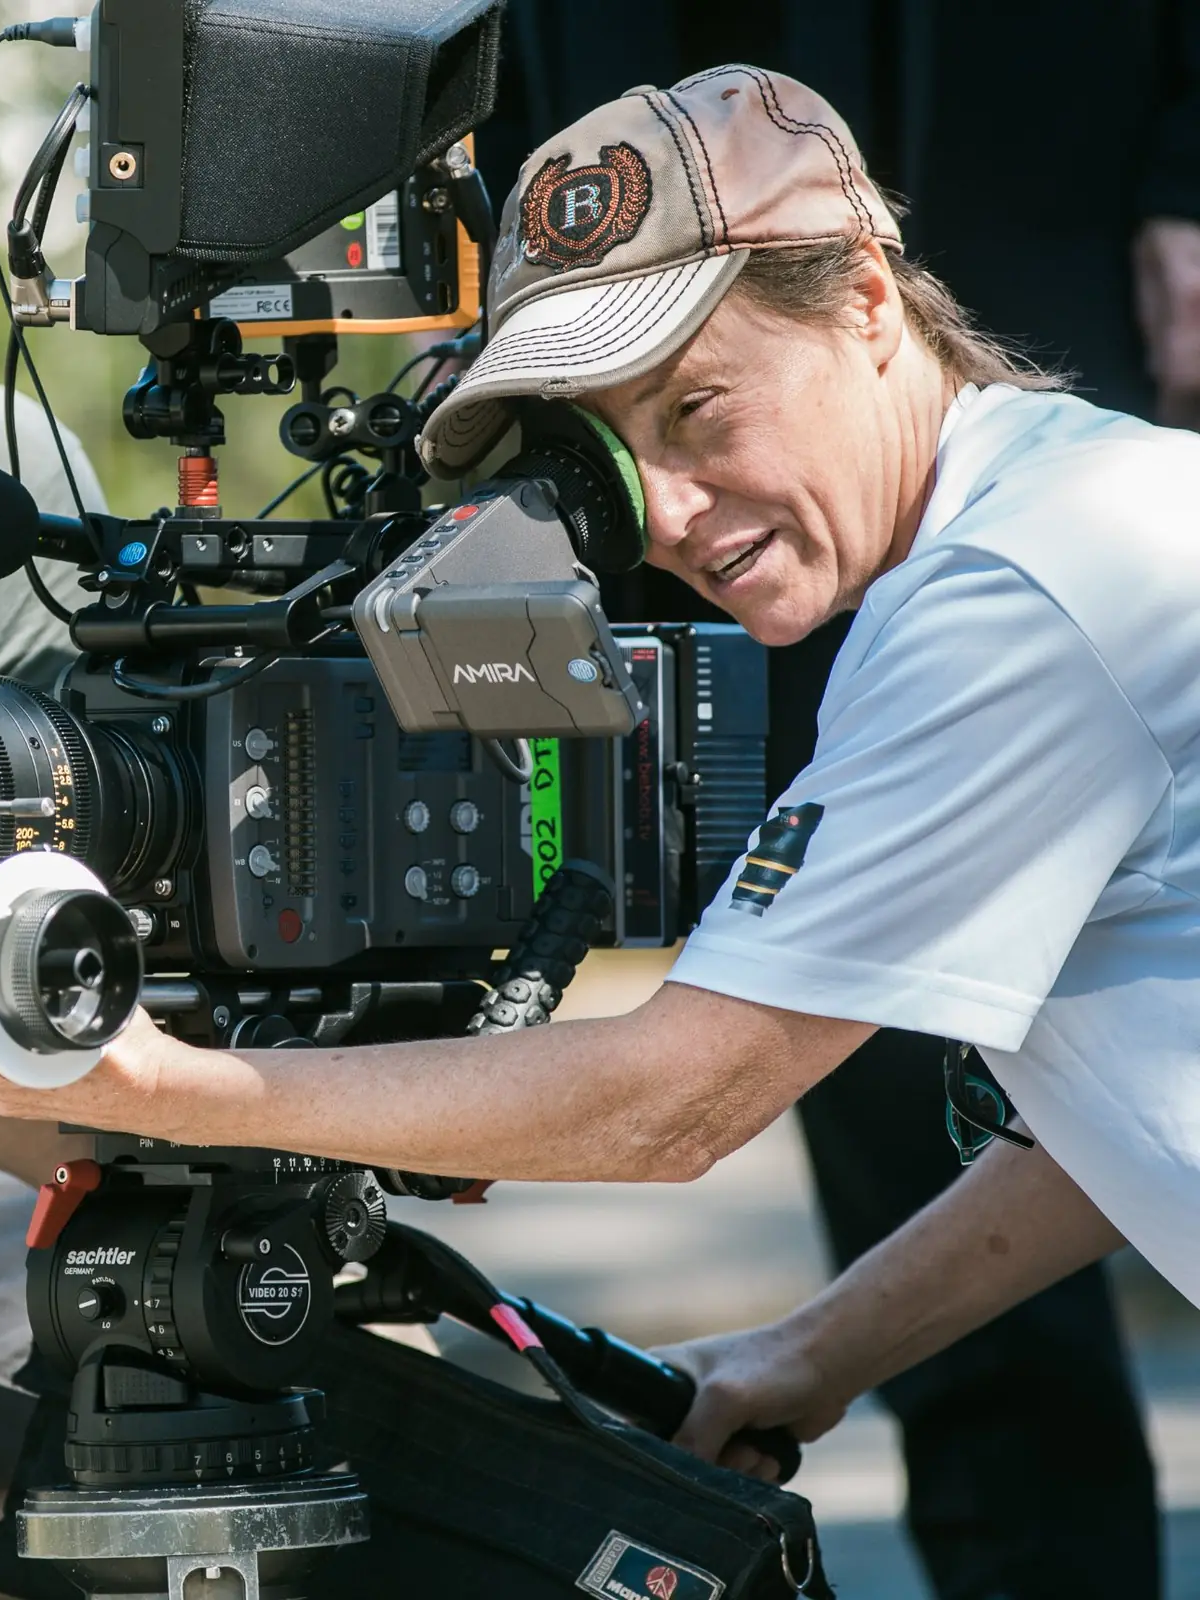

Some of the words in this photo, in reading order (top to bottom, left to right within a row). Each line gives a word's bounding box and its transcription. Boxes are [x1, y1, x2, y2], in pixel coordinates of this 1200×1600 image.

[561, 184, 602, 230] B
[453, 662, 536, 684] AMIRA
[534, 737, 555, 790] DT
[61, 819, 74, 829] 5.6
[16, 828, 34, 839] 200
[140, 1138, 154, 1148] PIN
[273, 1158, 281, 1167] 12
[289, 1158, 296, 1167] 11
[304, 1158, 312, 1167] 10
[66, 1247, 136, 1265] sachtler
[249, 1287, 276, 1298] VIDEO
[278, 1287, 289, 1298] 20
[154, 1300, 160, 1308] 7
[102, 1321, 111, 1329] LO
[158, 1325, 165, 1334] 6
[167, 1348, 174, 1357] 5
[194, 1455, 202, 1465] 7
[226, 1453, 233, 1462] 6
[255, 1450, 261, 1459] 5
[593, 1541, 621, 1584] GRUPPO
